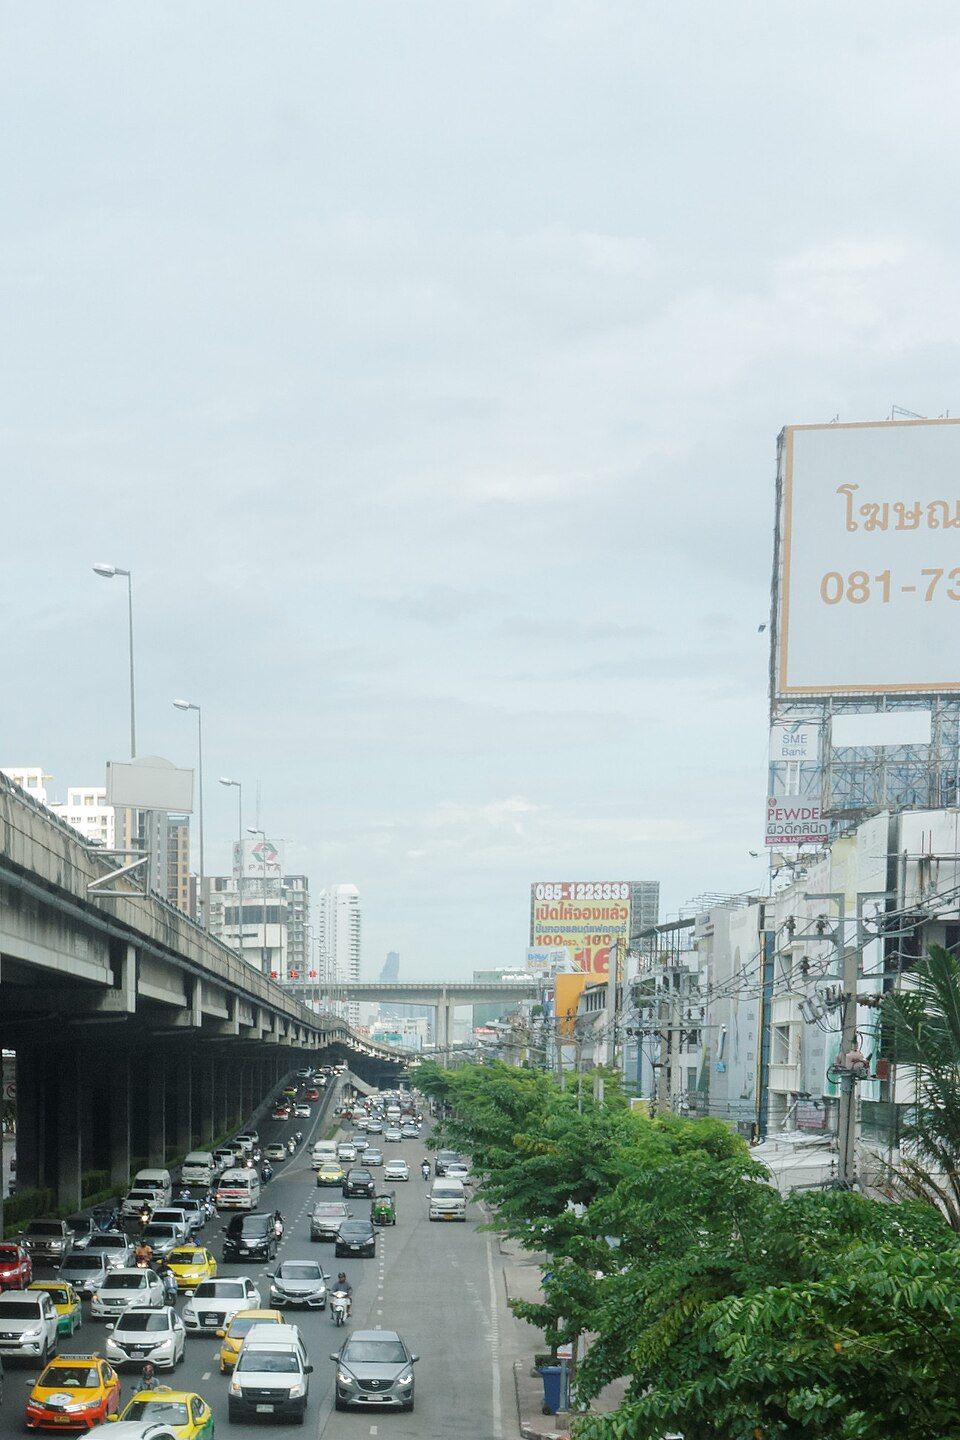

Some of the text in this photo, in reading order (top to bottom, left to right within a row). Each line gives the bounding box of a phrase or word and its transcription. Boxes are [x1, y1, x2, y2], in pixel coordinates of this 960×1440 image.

[820, 567, 960, 605] 081-73
[782, 734, 808, 744] SME
[781, 747, 807, 757] Bank
[767, 807, 820, 821] PEWDE
[536, 883, 629, 900] 085-1223339
